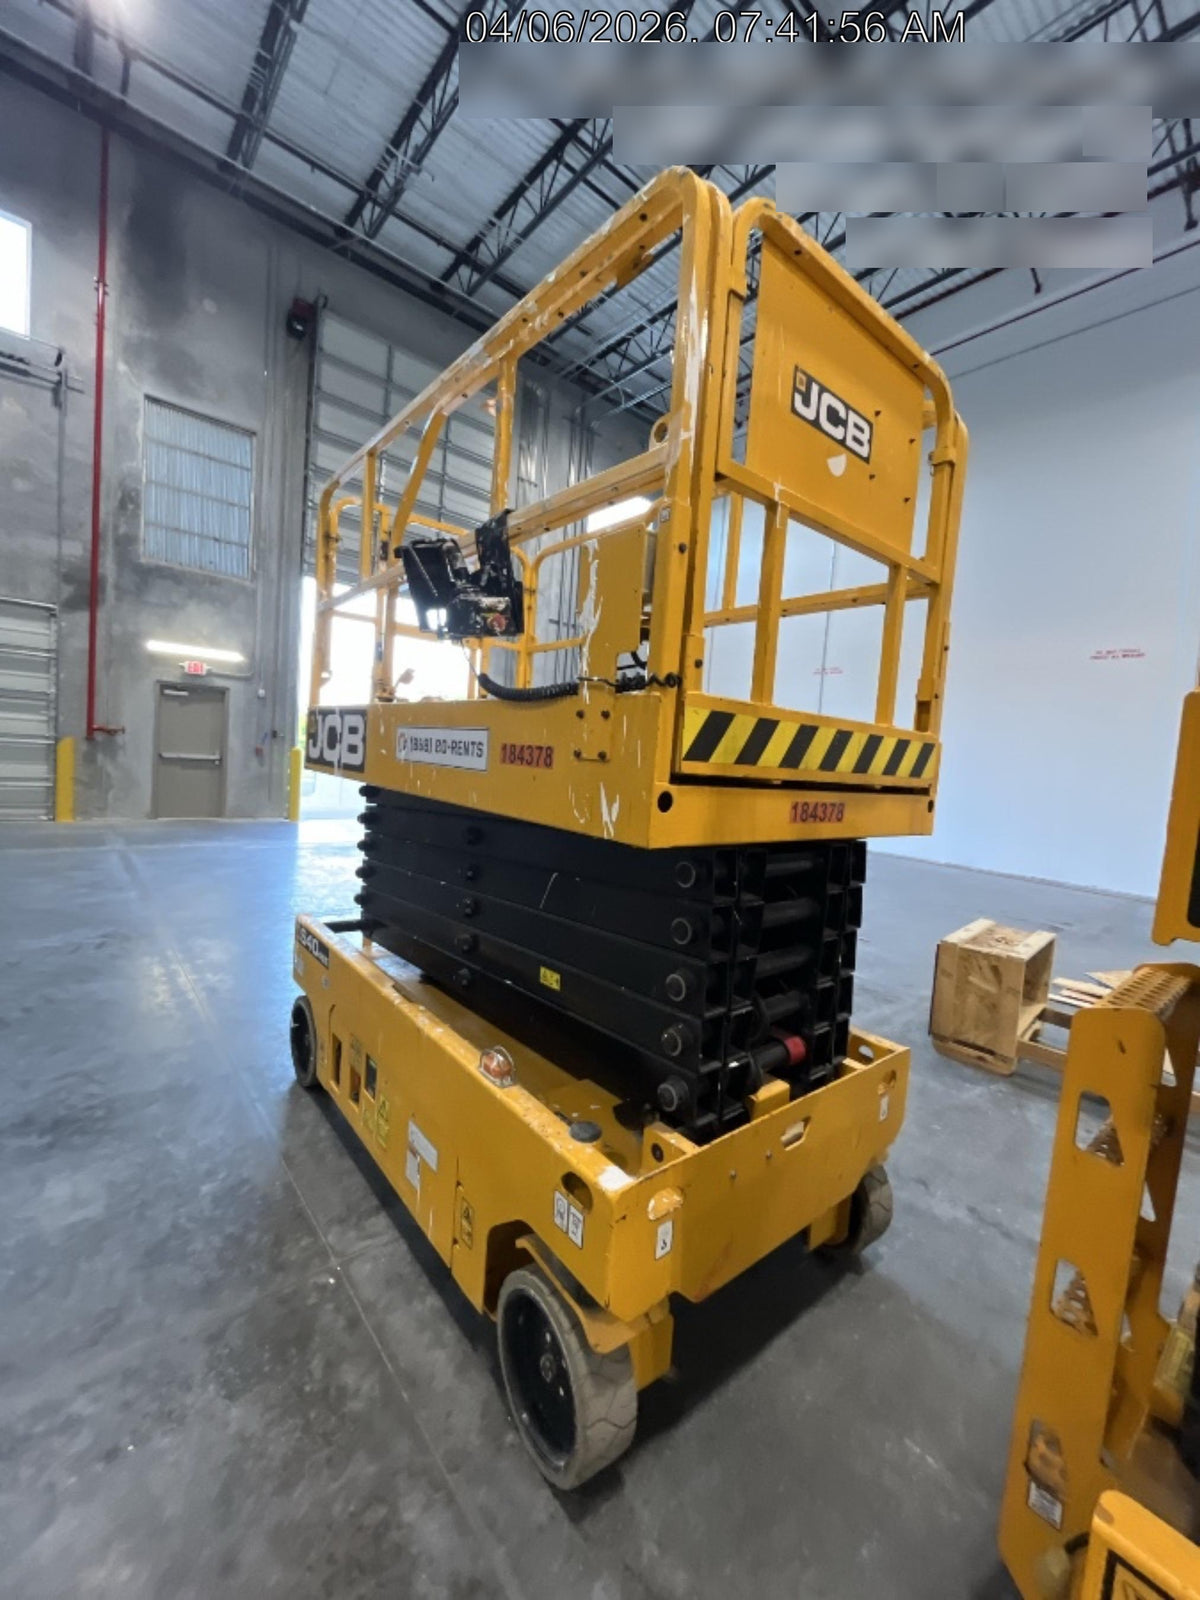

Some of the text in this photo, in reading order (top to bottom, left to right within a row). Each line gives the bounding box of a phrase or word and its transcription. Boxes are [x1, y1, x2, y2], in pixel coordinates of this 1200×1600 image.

[794, 381, 870, 458] JCB
[309, 714, 364, 765] JCB
[502, 743, 554, 768] 184378
[791, 801, 845, 822] 184378
